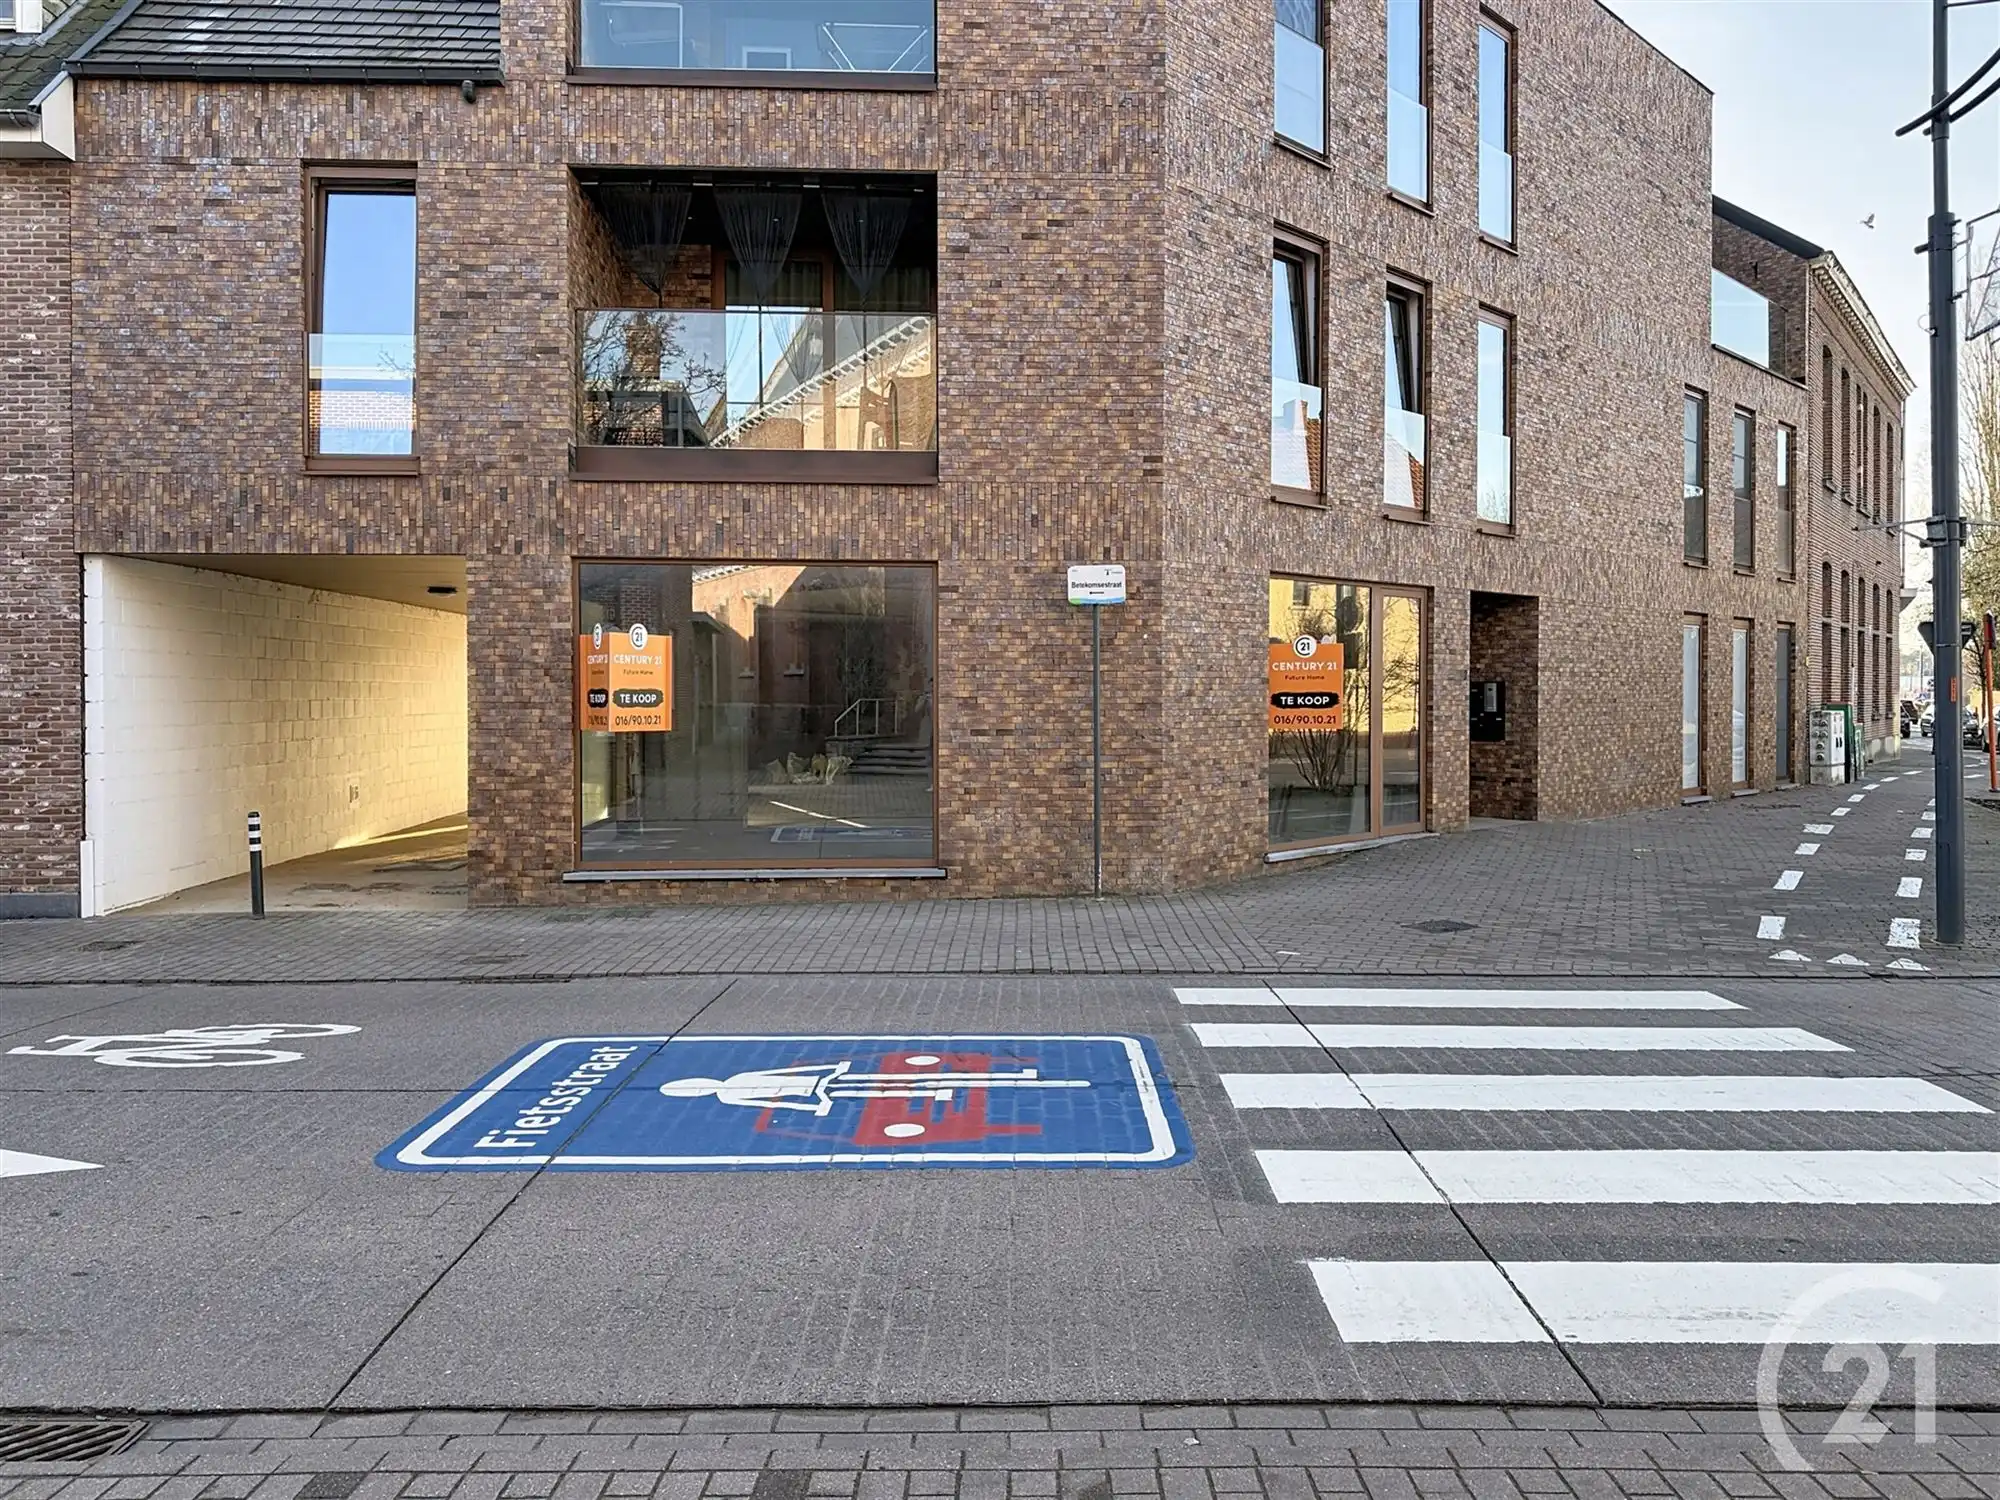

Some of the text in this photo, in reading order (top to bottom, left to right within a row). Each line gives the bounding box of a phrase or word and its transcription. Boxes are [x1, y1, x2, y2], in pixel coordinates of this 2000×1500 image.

[1300, 642, 1310, 651] 21
[614, 655, 652, 664] CENTURY
[654, 655, 663, 665] 21
[1272, 662, 1337, 671] CENTURY 21
[620, 694, 657, 703] TE KOOP
[1280, 696, 1330, 705] TE KOOP
[615, 715, 661, 726] 016/90.10.21
[1273, 715, 1337, 725] 016/90.10.21
[473, 1045, 638, 1148] Fietsstraat
